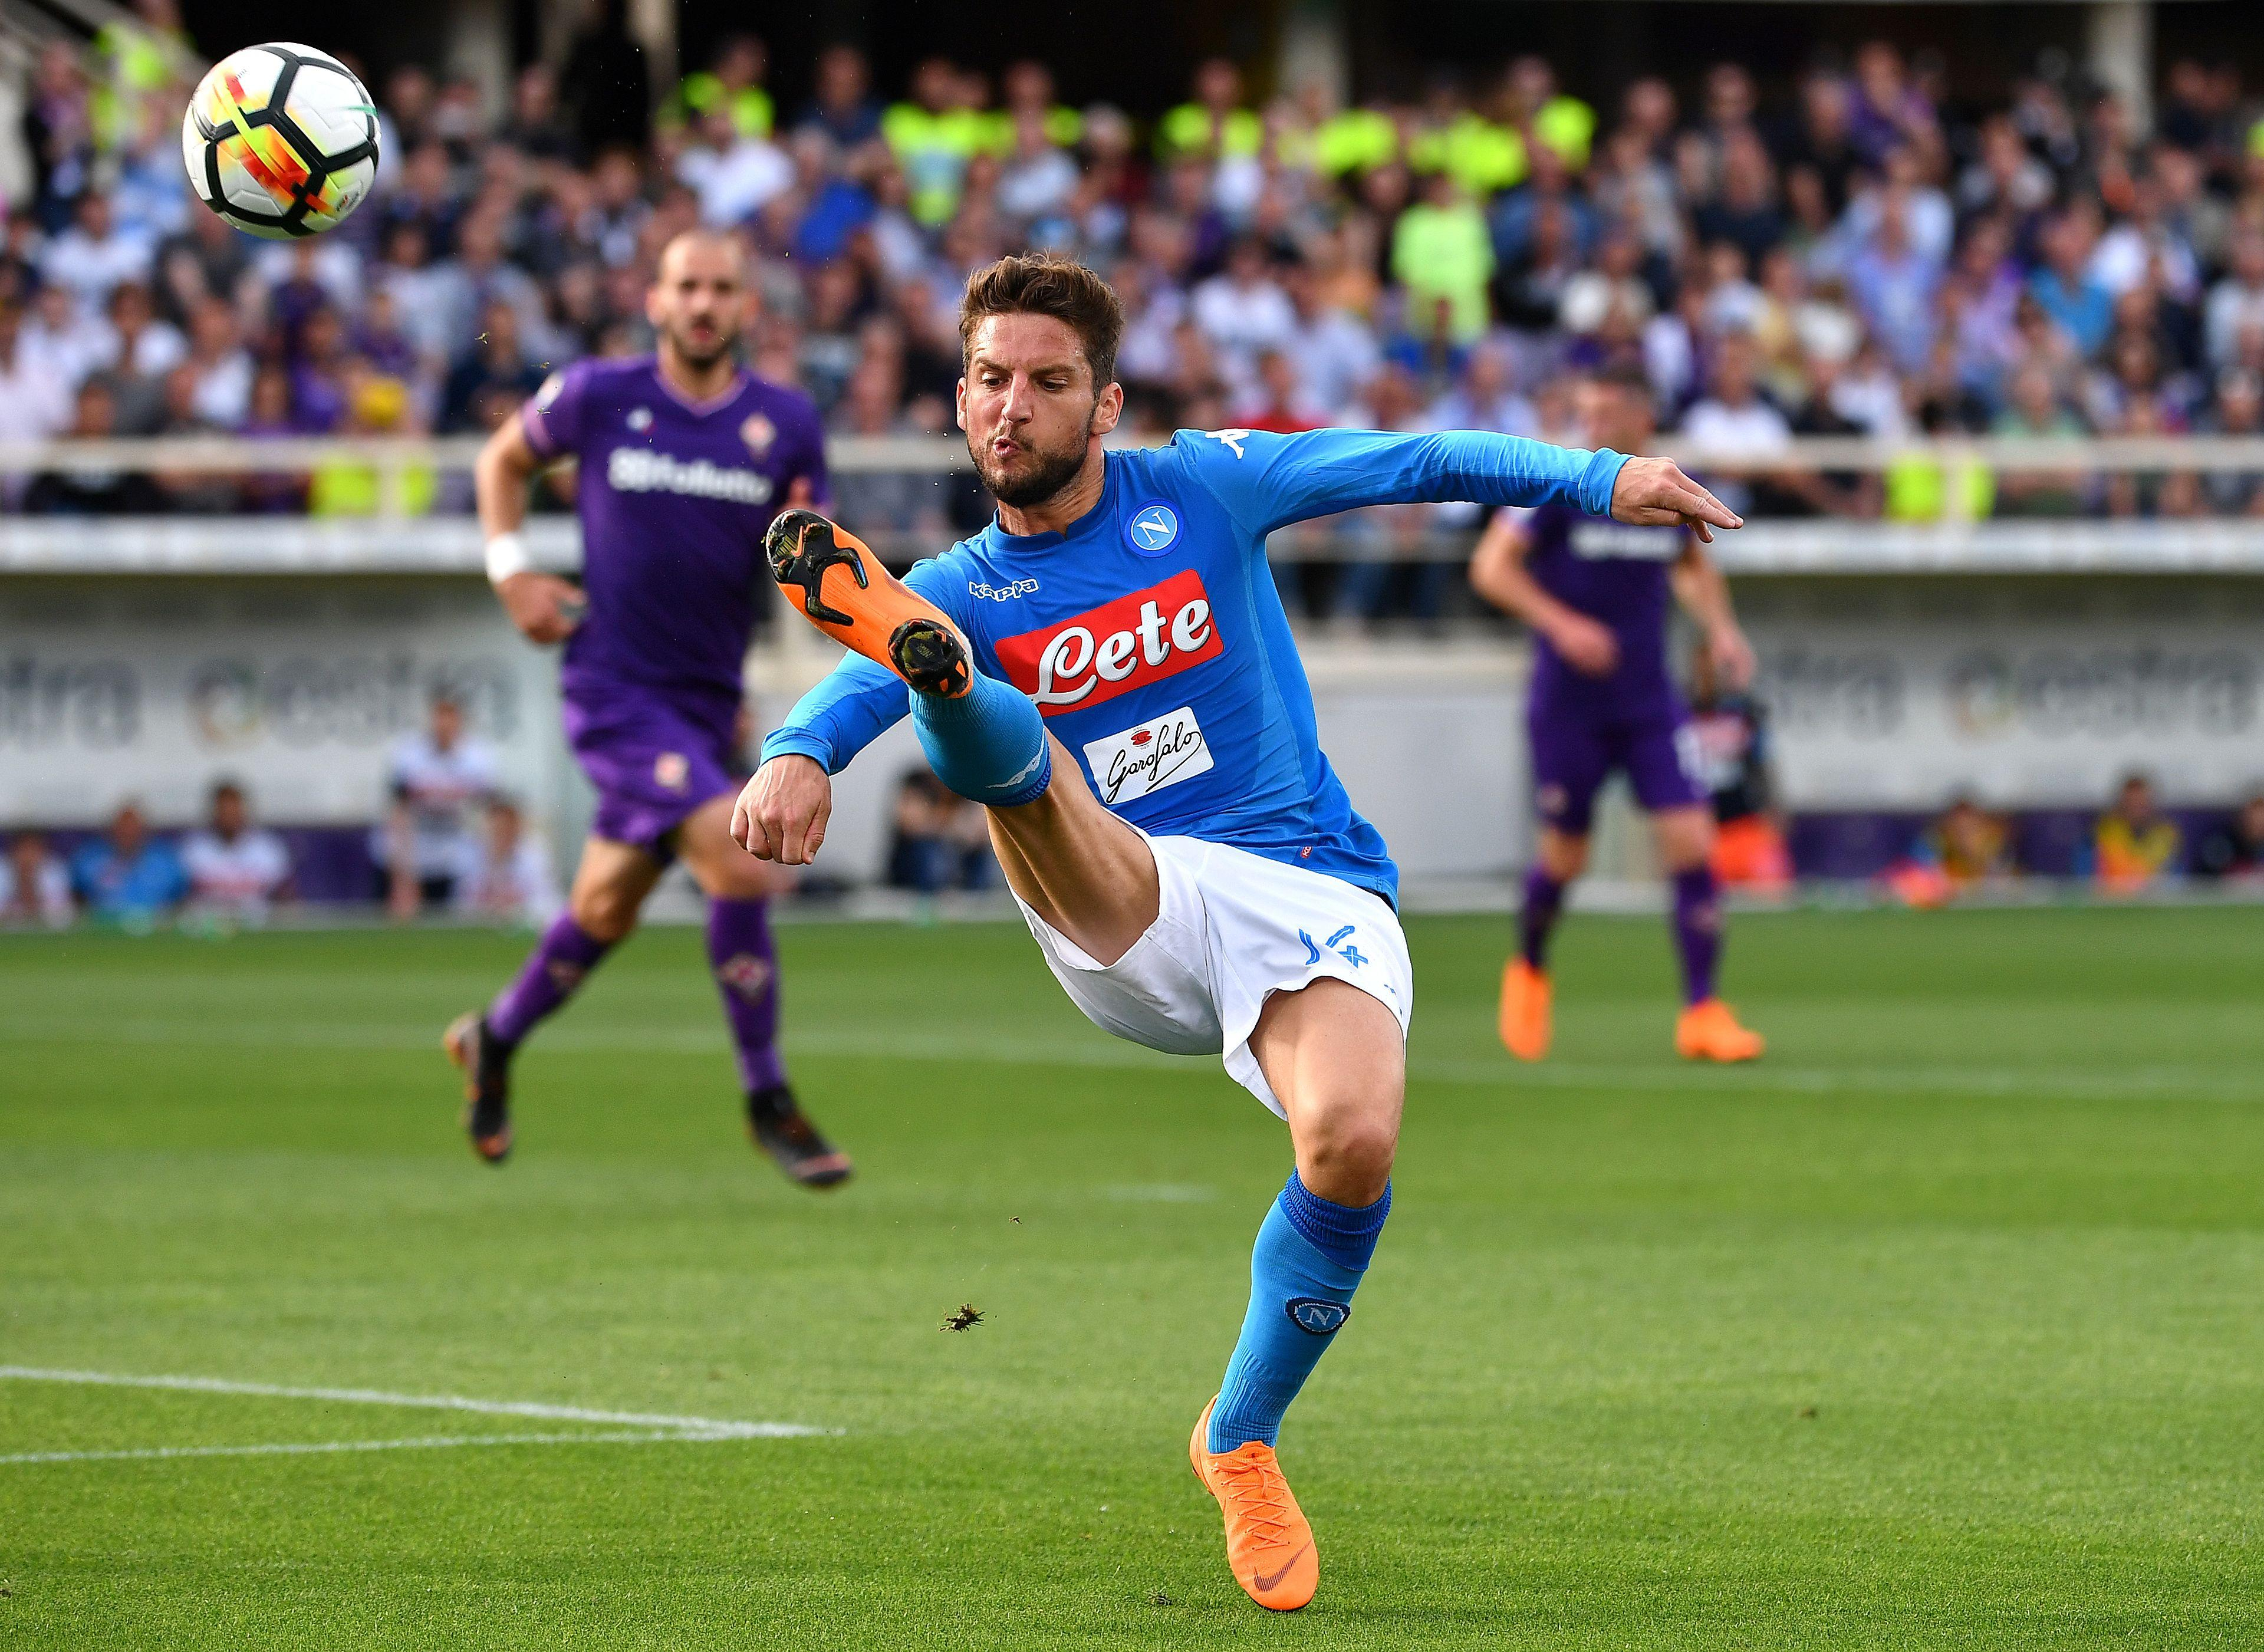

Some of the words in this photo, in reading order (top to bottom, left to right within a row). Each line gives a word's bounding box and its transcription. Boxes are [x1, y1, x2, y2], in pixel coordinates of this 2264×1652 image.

[1137, 510, 1170, 547] N
[1029, 598, 1211, 707] Lete
[1106, 721, 1202, 804] Garofalo
[1305, 1307, 1333, 1327] N
